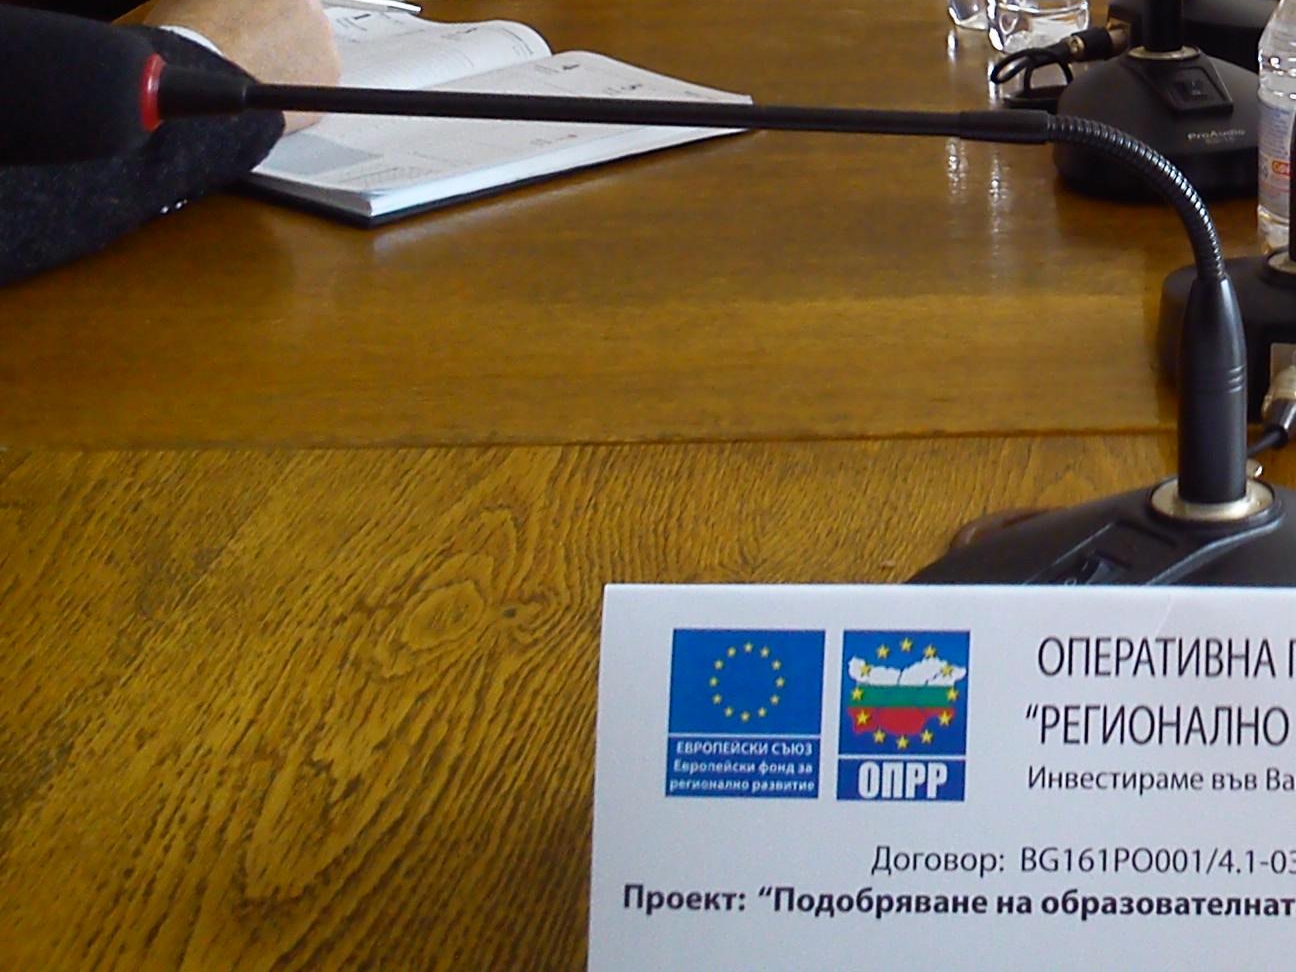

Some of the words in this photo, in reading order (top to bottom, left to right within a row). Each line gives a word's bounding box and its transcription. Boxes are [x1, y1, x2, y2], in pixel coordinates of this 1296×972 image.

[1038, 636, 1276, 680] ОПЕРАТИВНА
[1025, 703, 1290, 748] “РЕГИОНАЛНО
[676, 740, 768, 754] ЕВРОПЕЙСКИ
[771, 742, 813, 756] СЪЮЗ
[673, 759, 756, 775] Европейски
[758, 760, 795, 775] фонд
[797, 764, 813, 774] за
[858, 762, 947, 799] ОПРР
[1028, 765, 1205, 797] Инвестираме
[1212, 772, 1258, 792] във
[669, 778, 750, 791] регионално
[751, 780, 815, 794] развитие
[871, 845, 1005, 880] Договор:
[623, 883, 747, 917] Проект:
[757, 885, 989, 921] “Подобряване
[996, 895, 1033, 915] на
